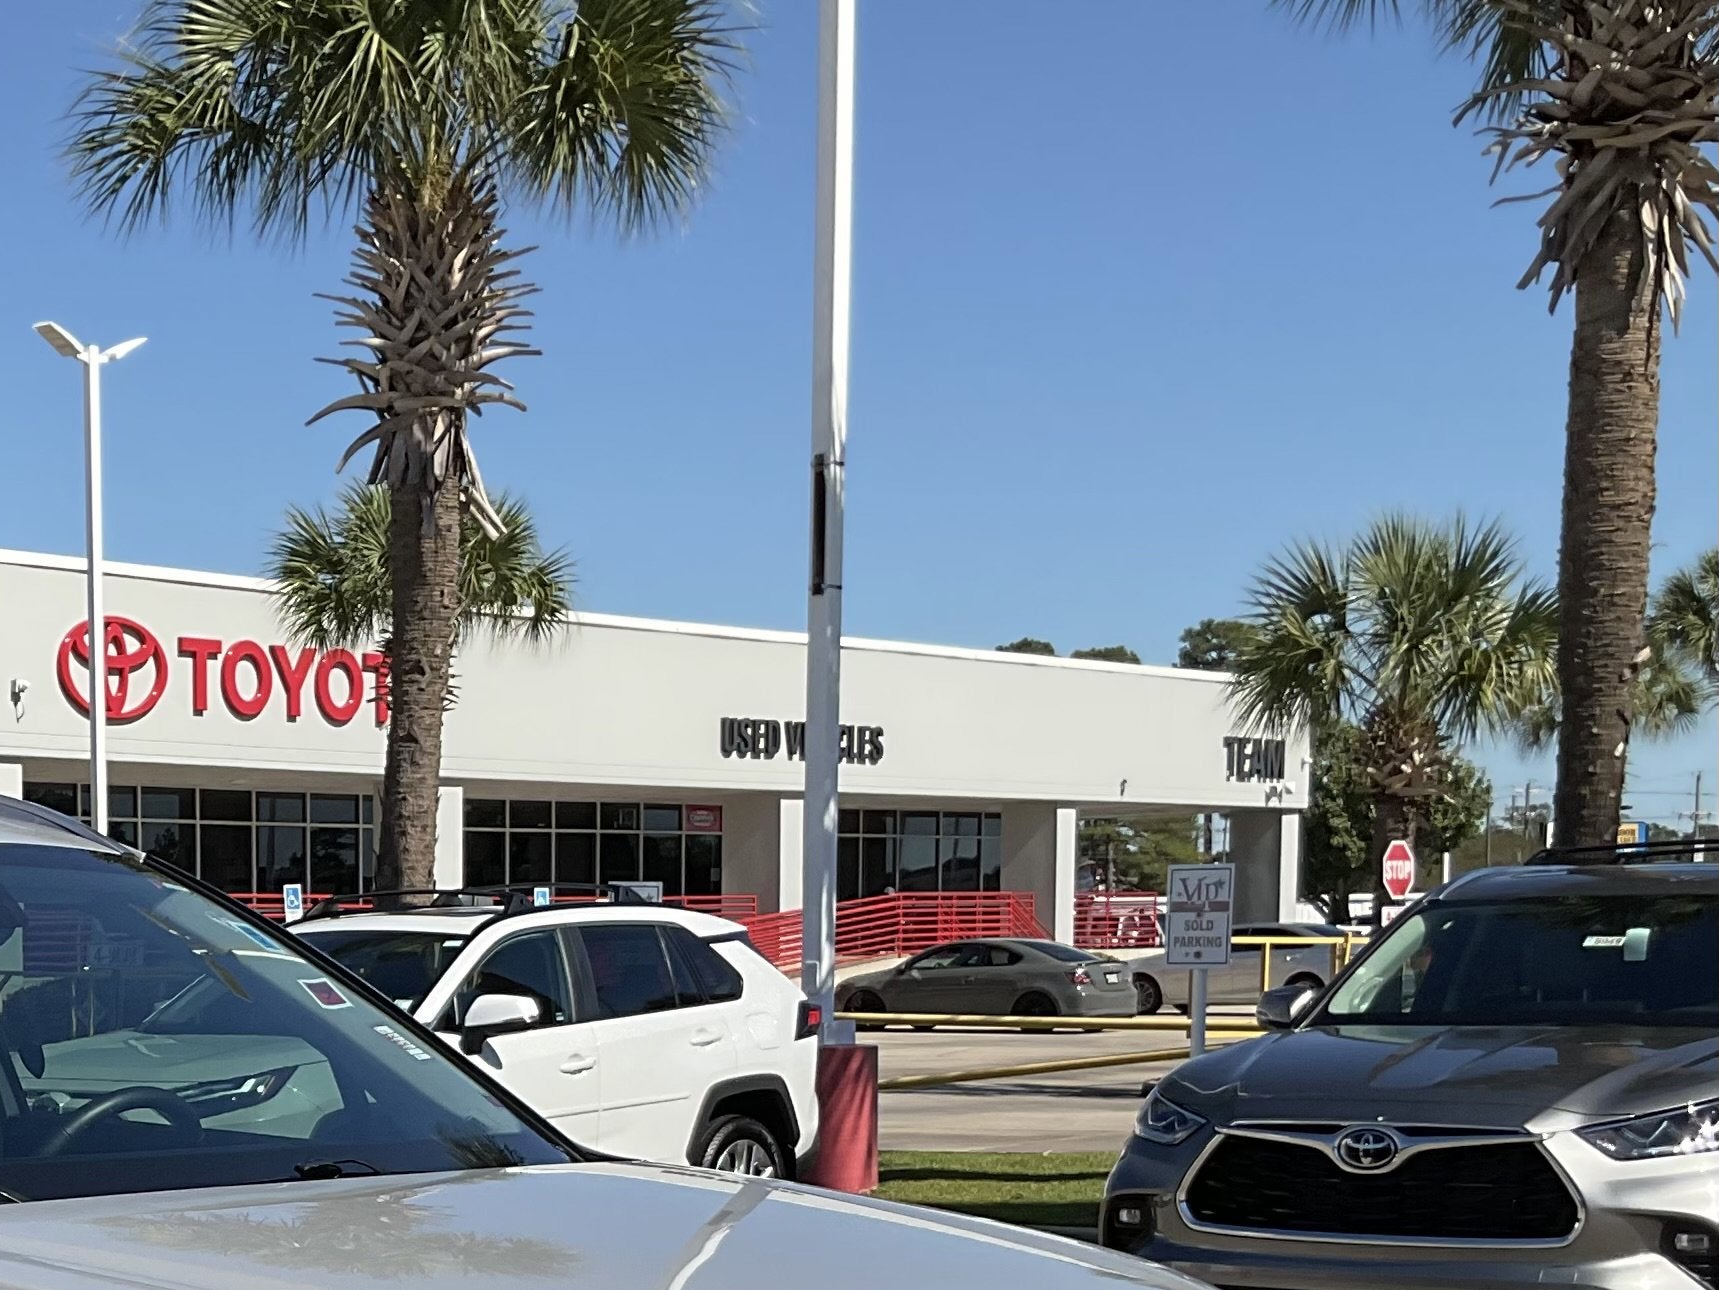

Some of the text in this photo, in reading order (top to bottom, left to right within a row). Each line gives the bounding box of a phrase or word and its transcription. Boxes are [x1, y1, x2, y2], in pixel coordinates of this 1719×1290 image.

[177, 636, 392, 729] TOYOT
[720, 717, 781, 759] USED
[1223, 736, 1285, 783] TEAM
[1385, 860, 1411, 880] STOP
[1184, 919, 1214, 931] SOLD
[1173, 936, 1222, 948] PARKING
